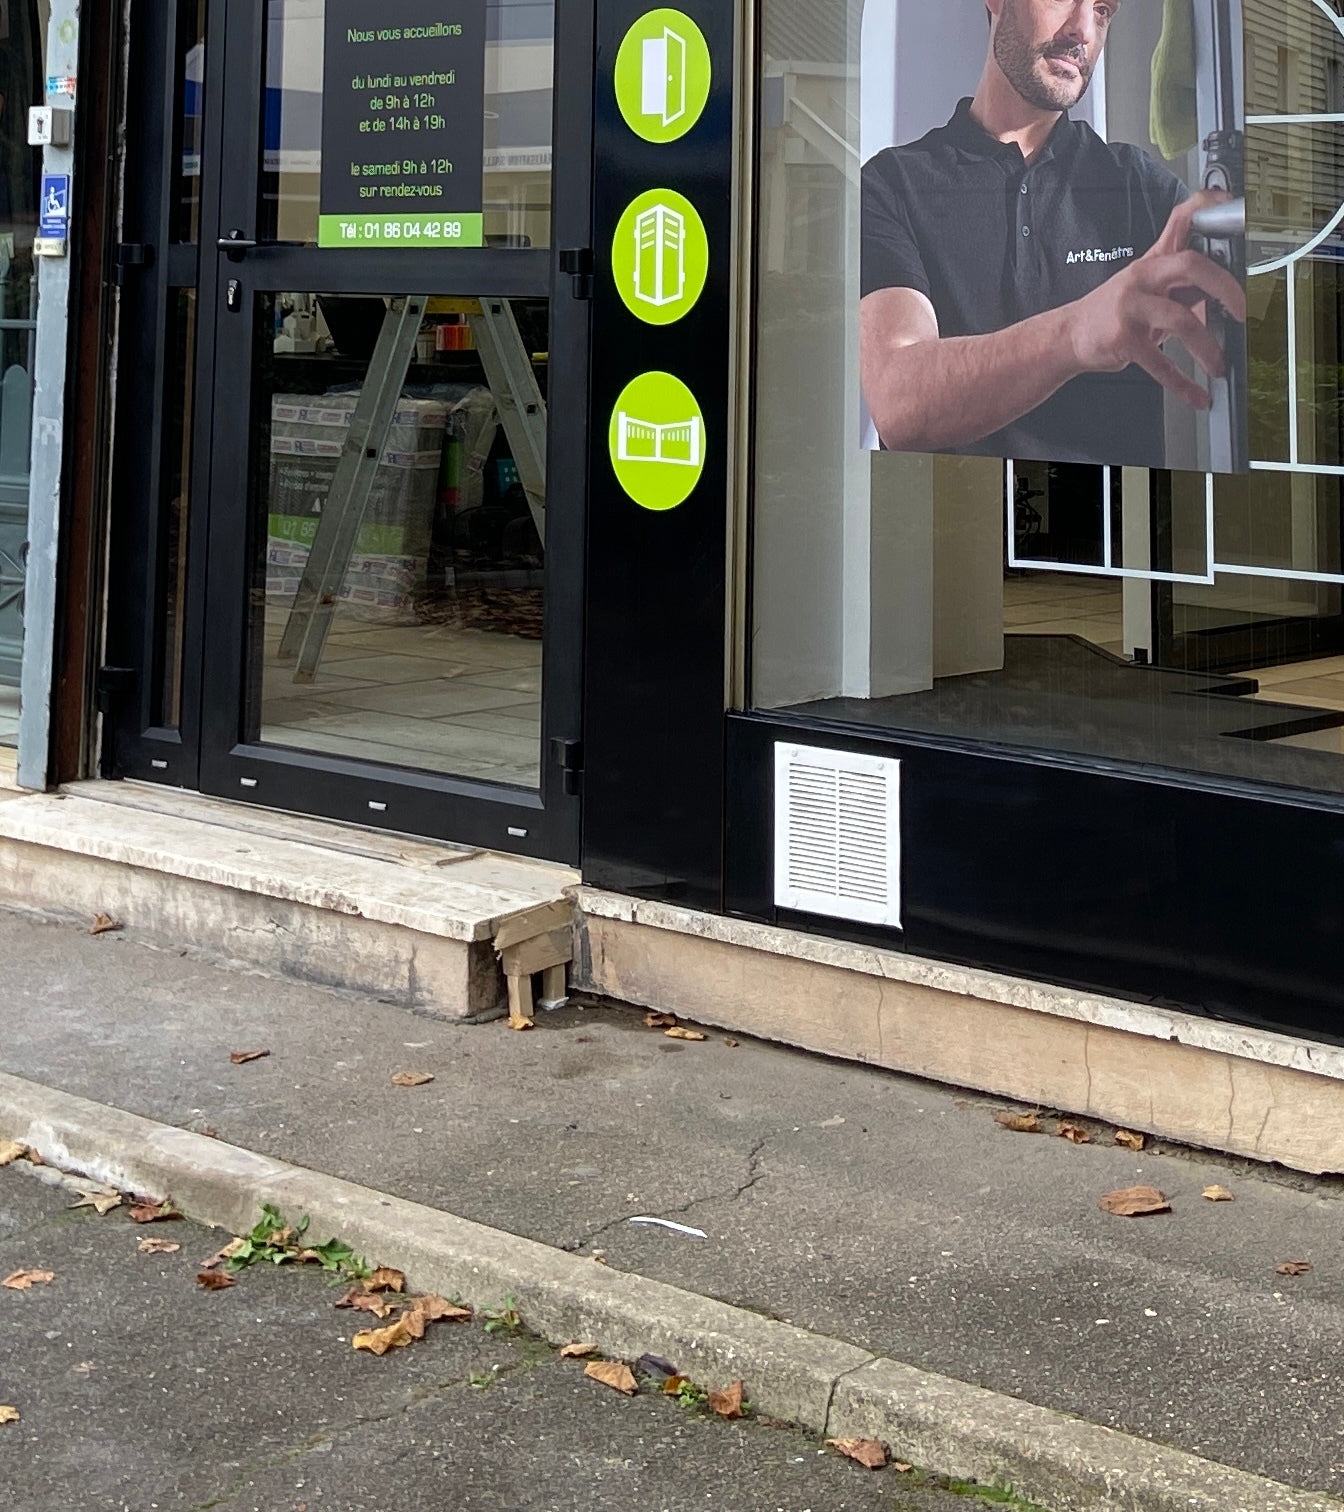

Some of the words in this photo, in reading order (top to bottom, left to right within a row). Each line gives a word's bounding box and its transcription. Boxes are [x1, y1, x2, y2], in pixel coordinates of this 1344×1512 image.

[347, 28, 375, 43] Nous
[377, 27, 401, 40] vous
[404, 22, 462, 39] accueillons
[352, 75, 365, 89] du
[367, 73, 392, 88] lundi
[394, 75, 407, 87] au
[409, 70, 455, 86] vendredi
[370, 96, 383, 110] de
[386, 95, 400, 109] 9h
[403, 94, 410, 108] à
[413, 93, 435, 108] 12h
[359, 120, 371, 133] et
[372, 117, 386, 131] de
[389, 117, 411, 131] 14h
[413, 115, 420, 129] à
[423, 115, 446, 129] 19h
[350, 162, 360, 177] le
[362, 160, 400, 175] samedi
[402, 160, 417, 174] 9h
[420, 159, 427, 174] à
[430, 159, 453, 173] 12h
[359, 185, 378, 198] sur
[380, 182, 443, 197] rendez-vous
[364, 222, 380, 238] 01
[384, 222, 400, 238] 86
[404, 221, 421, 238] 04
[423, 221, 441, 237] 42
